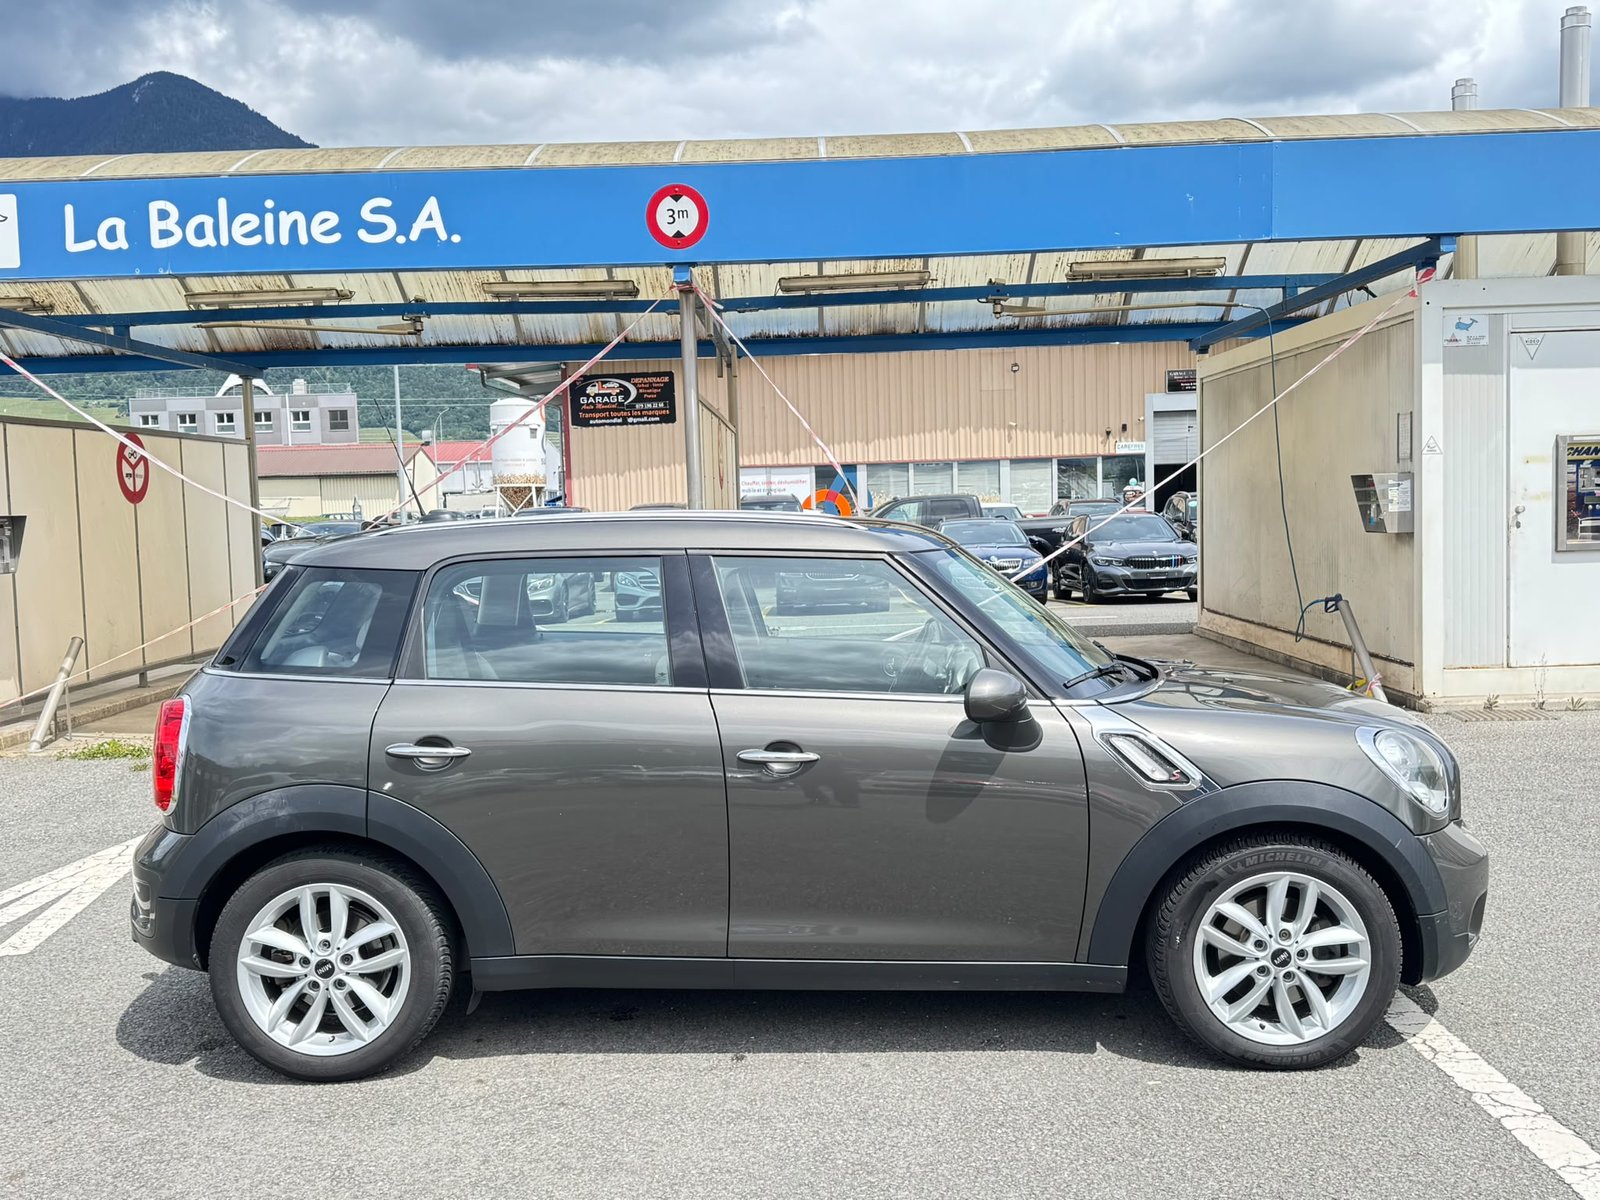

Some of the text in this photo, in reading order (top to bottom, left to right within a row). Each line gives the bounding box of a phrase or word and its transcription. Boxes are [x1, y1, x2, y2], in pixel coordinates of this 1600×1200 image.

[64, 195, 461, 253] La Baleine S.A.
[580, 395, 625, 404] GARAGE
[579, 411, 610, 419] Transport
[1245, 851, 1322, 868] MICHELIN
[1274, 951, 1289, 965] MINI
